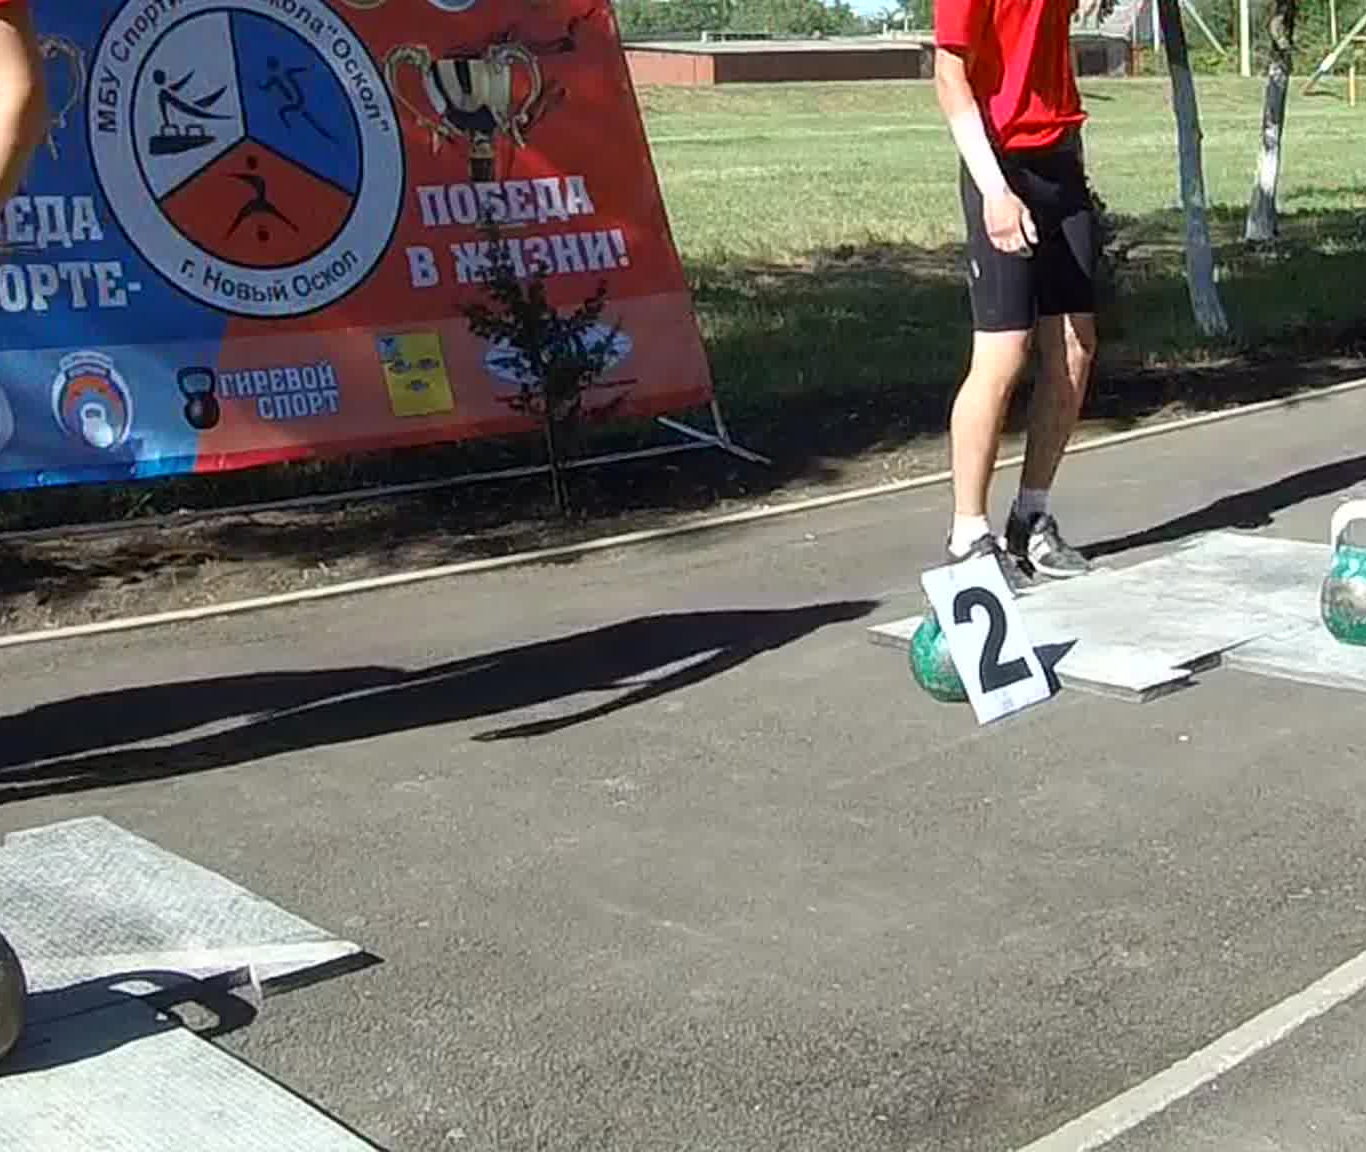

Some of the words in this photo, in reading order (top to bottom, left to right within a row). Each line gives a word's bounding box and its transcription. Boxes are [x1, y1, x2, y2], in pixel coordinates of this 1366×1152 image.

[98, 64, 121, 133] МБУ
[416, 175, 595, 226] ПОБЕДА
[180, 257, 196, 279] г.
[203, 265, 288, 303] Новый
[405, 244, 440, 288] В
[218, 359, 338, 397] ГИРЕВОЙ
[258, 389, 340, 420] СПОРТ
[953, 586, 1034, 694] 2
